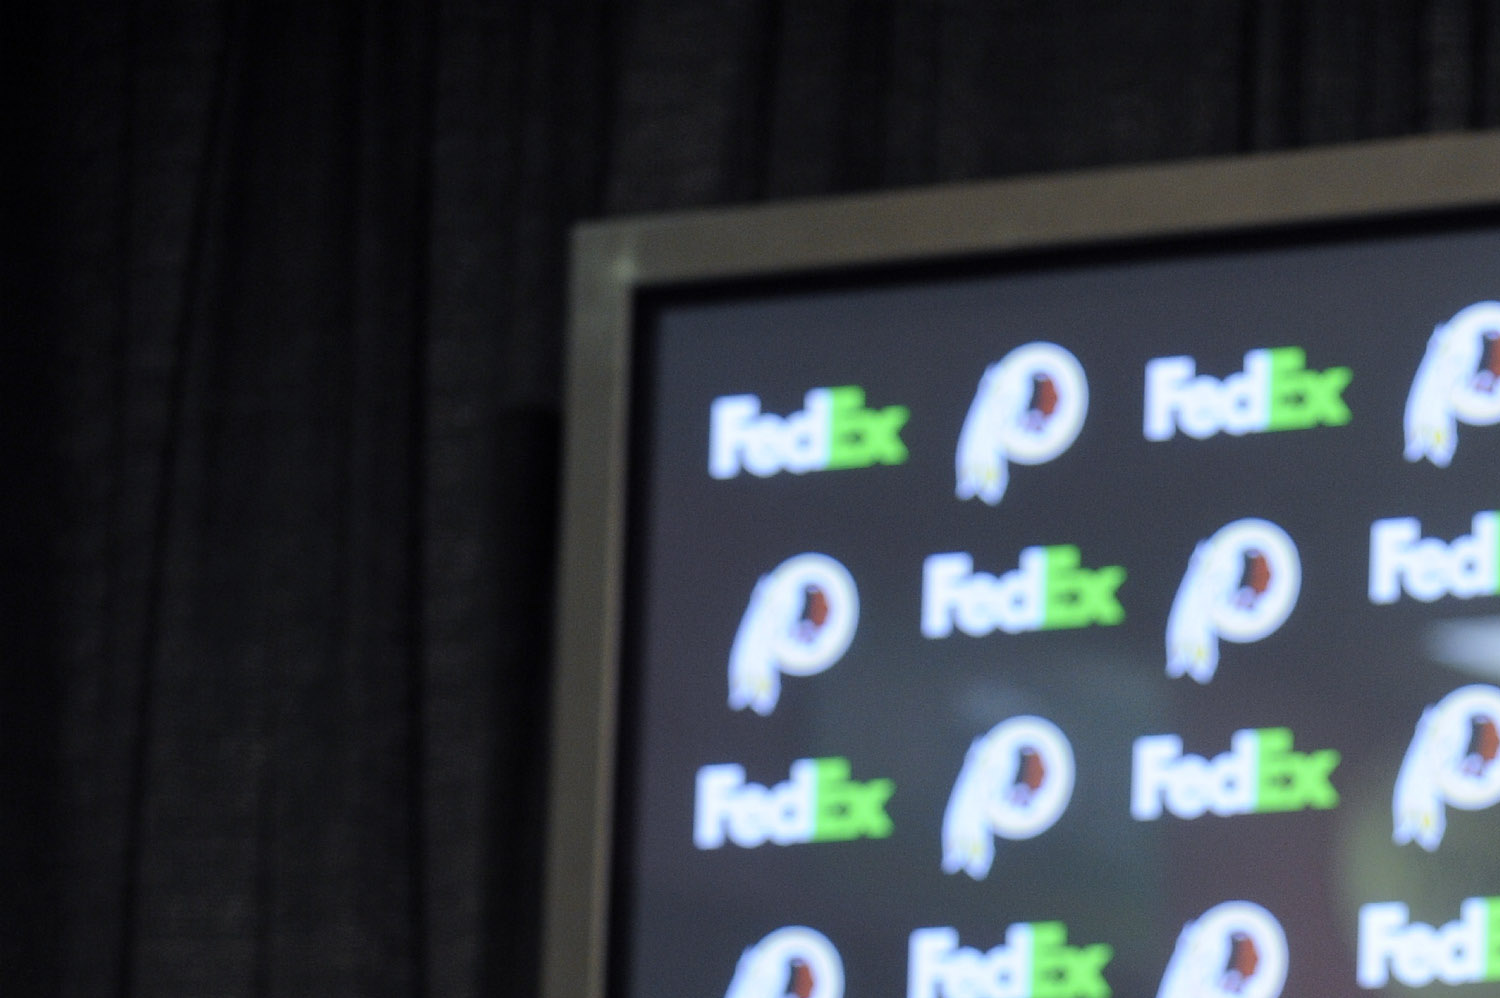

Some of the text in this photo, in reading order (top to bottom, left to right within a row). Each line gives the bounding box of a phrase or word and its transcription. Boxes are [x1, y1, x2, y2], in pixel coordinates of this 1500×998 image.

[709, 386, 909, 479] FedEx
[1144, 347, 1352, 441] FedEx
[921, 545, 1125, 639] FedEx
[694, 757, 894, 849] FedEx
[1130, 728, 1338, 821] FedEx
